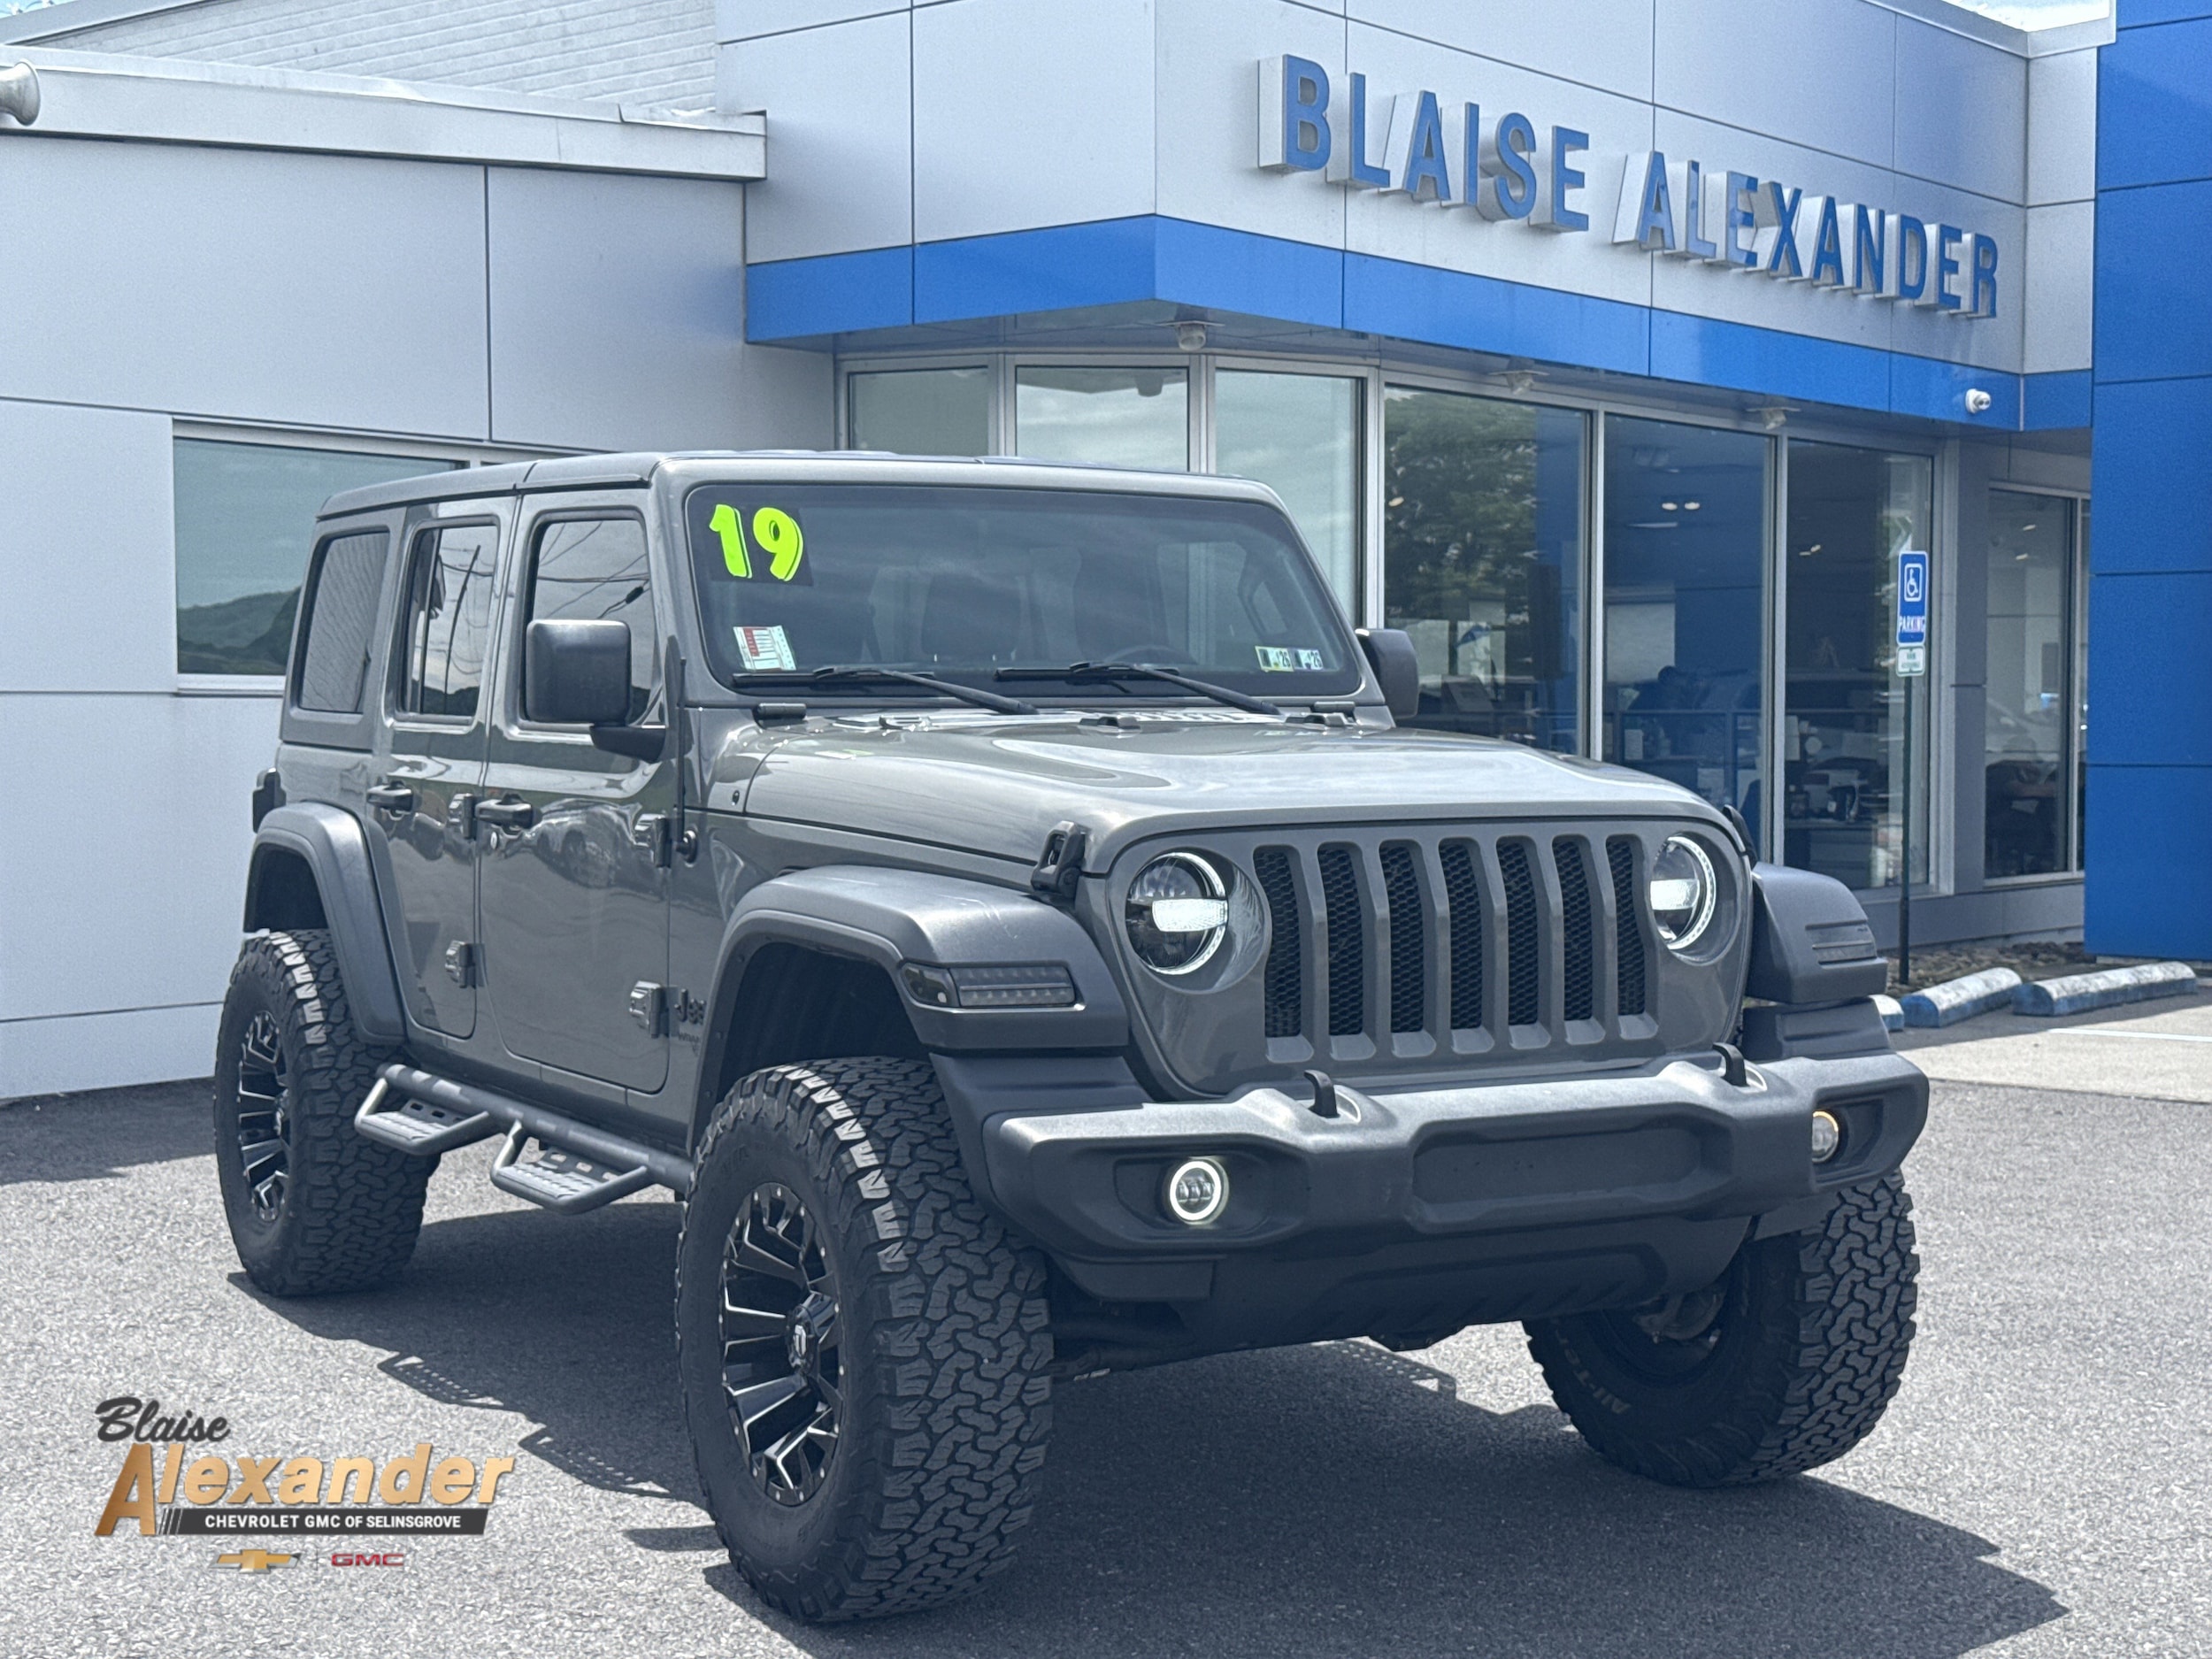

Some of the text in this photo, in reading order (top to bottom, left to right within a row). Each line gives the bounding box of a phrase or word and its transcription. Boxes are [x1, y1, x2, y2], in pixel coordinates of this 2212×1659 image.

[1260, 54, 1999, 319] BLAISE ALEXANDER
[710, 503, 803, 581] 19
[1899, 615, 1926, 633] PARKING
